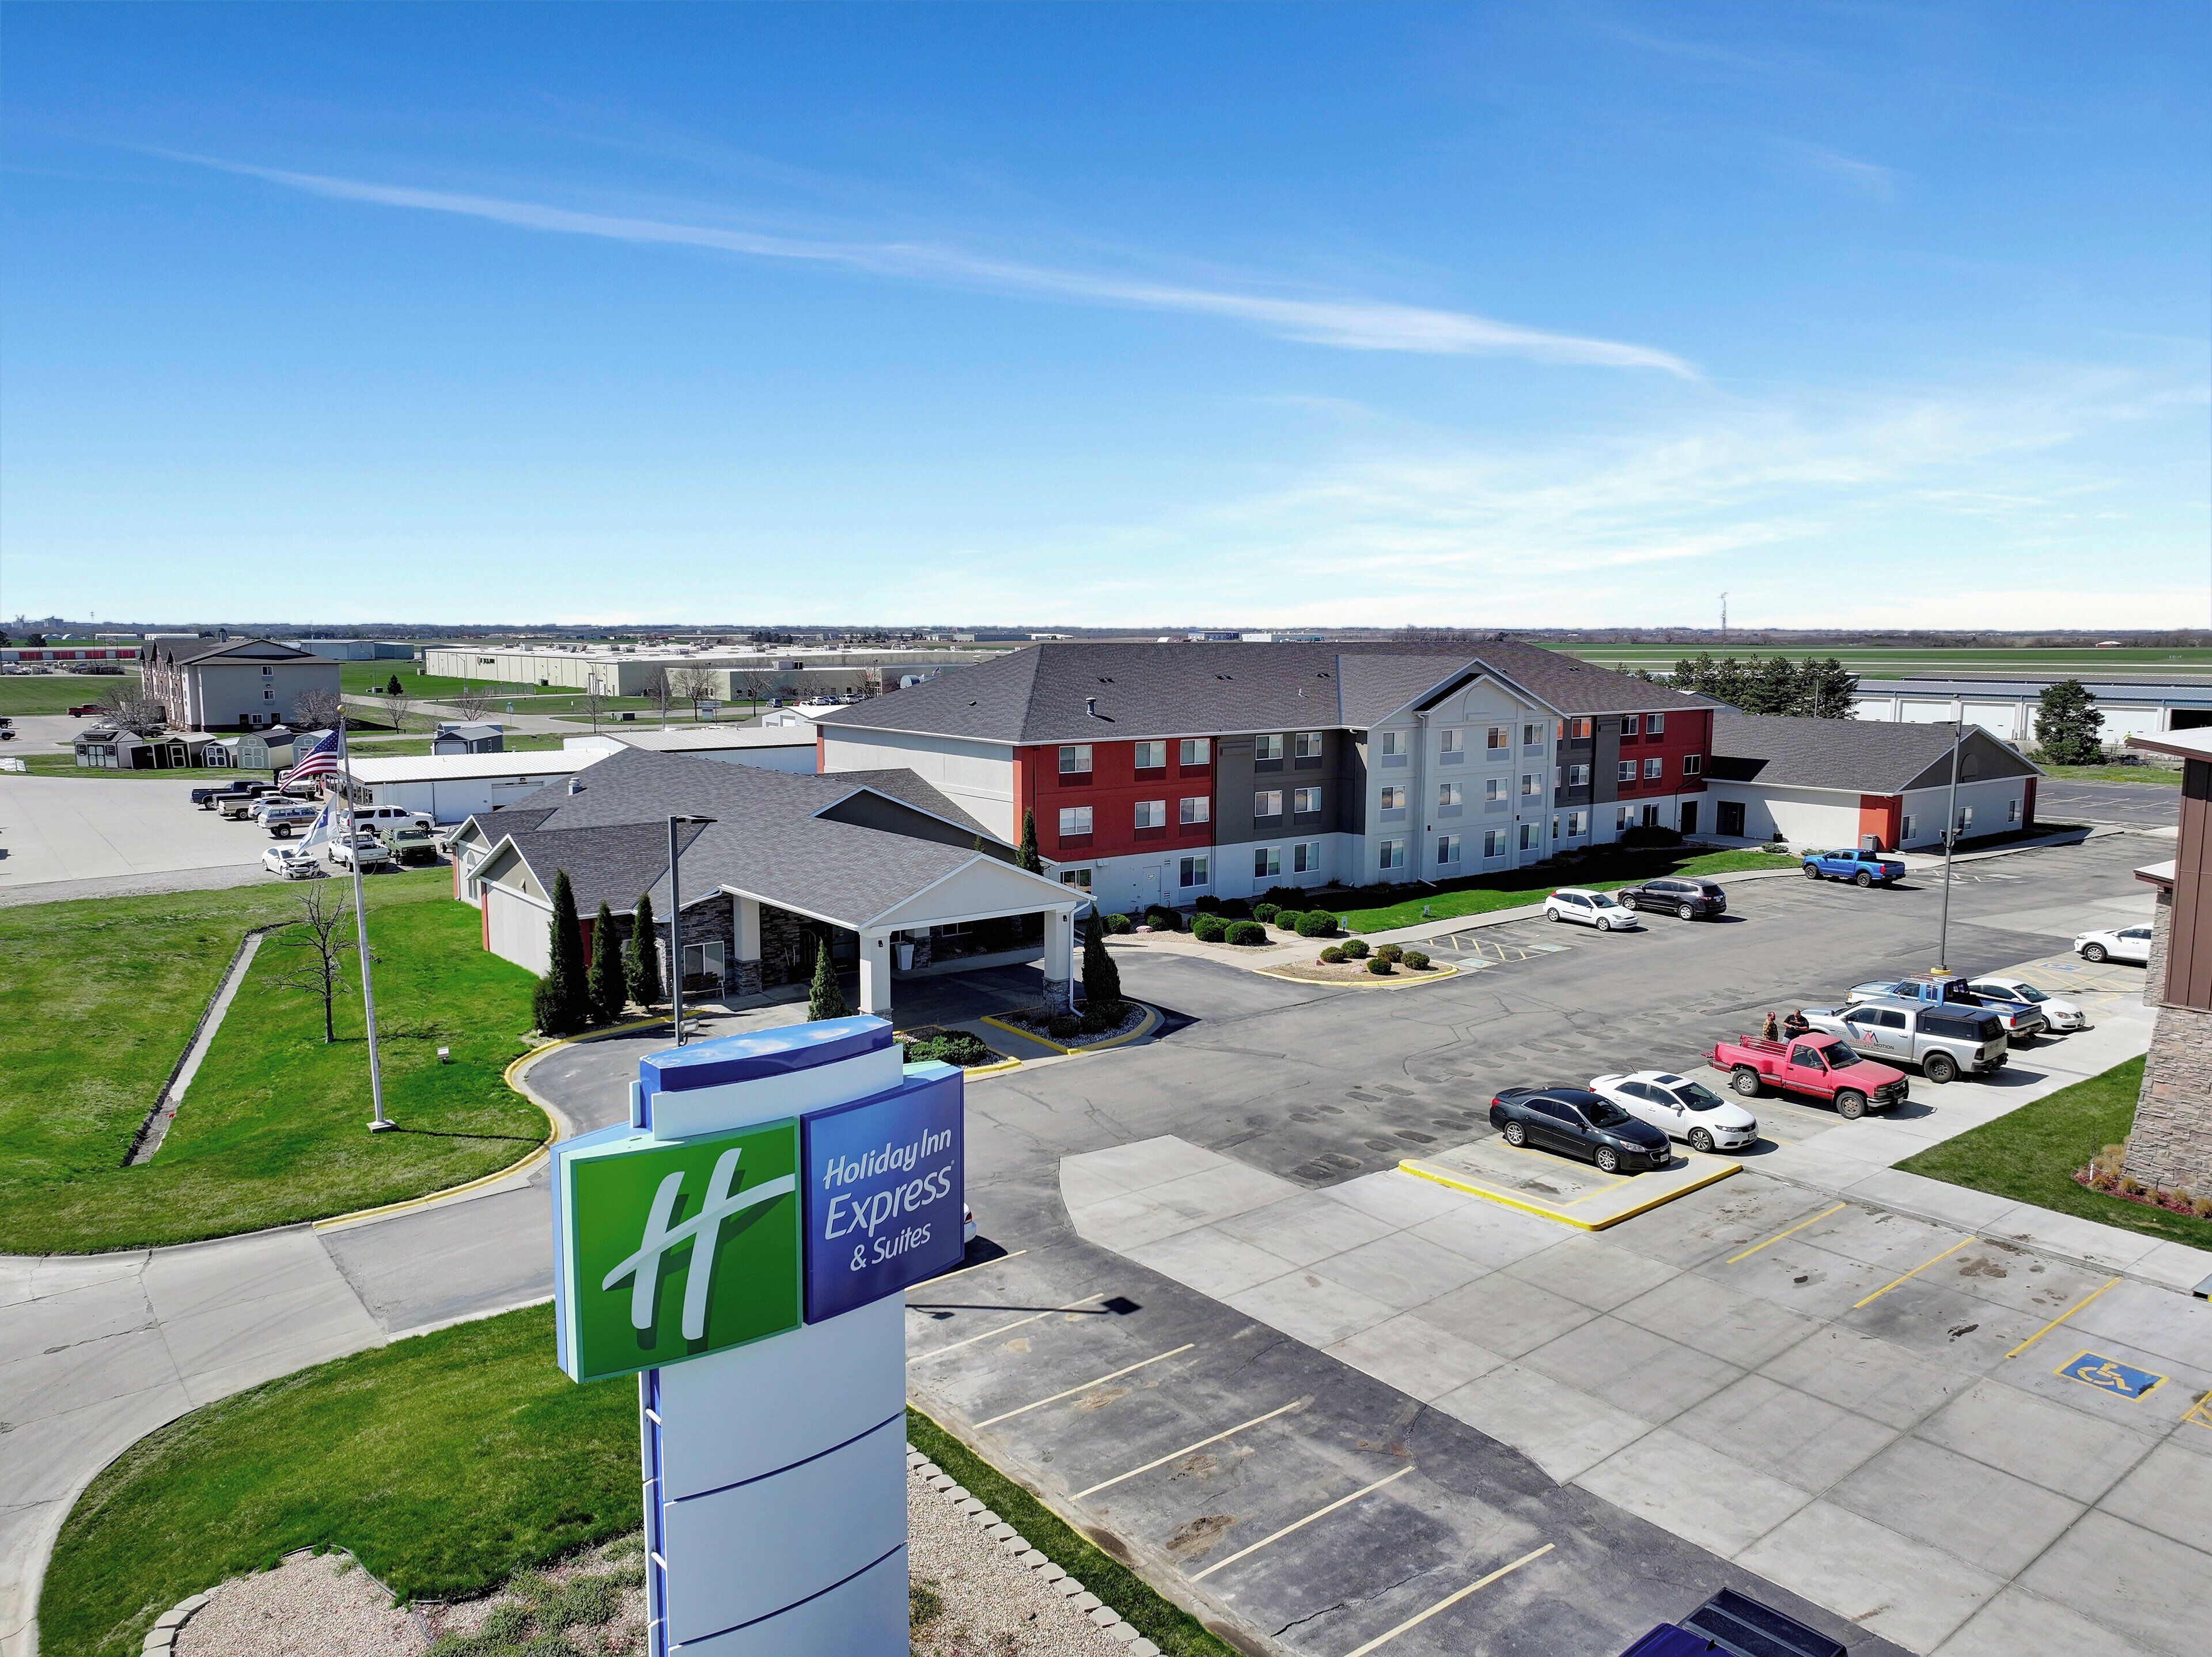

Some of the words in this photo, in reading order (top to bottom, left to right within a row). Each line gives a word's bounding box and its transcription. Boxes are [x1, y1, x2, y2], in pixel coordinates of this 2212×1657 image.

[823, 1141, 918, 1190] Holiday
[921, 1128, 951, 1158] Inn
[825, 1166, 952, 1240] Express
[602, 1148, 795, 1340] H
[850, 1244, 867, 1271] &
[871, 1223, 931, 1264] Suites
